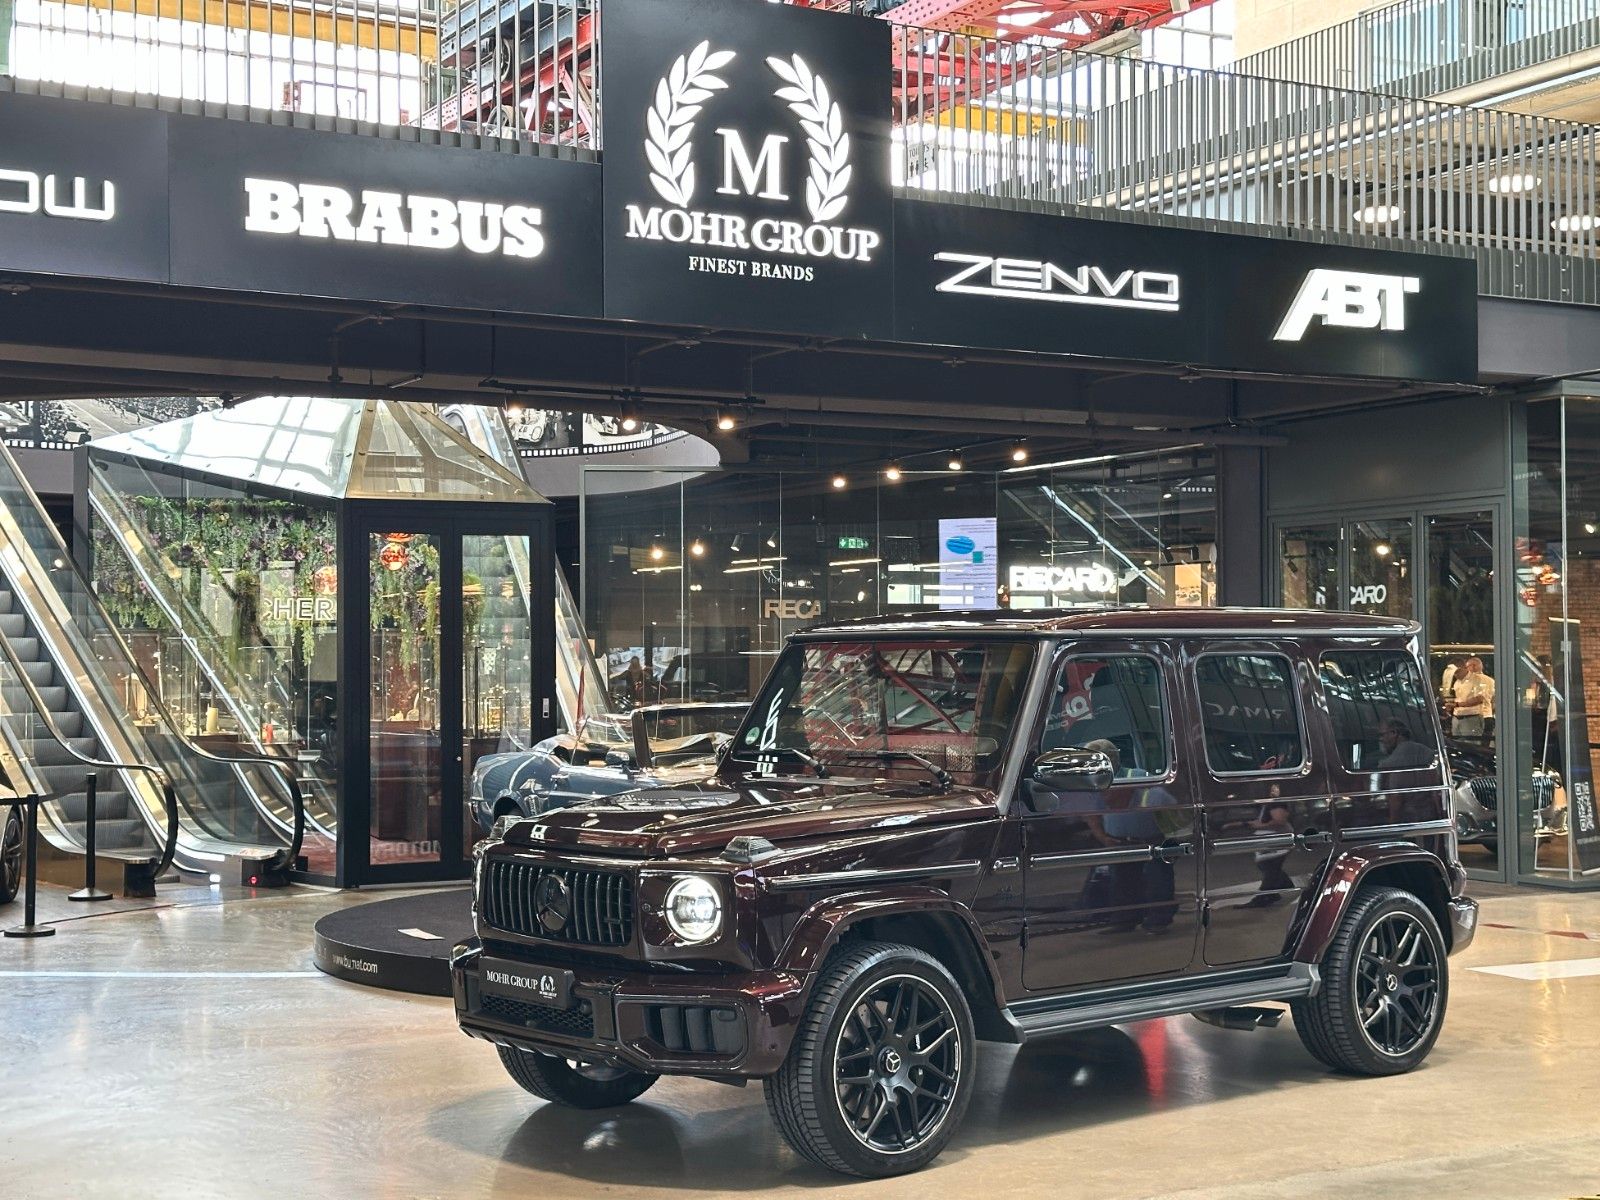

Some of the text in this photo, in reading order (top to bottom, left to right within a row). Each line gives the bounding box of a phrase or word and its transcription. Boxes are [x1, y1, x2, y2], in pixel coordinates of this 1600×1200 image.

[715, 128, 790, 201] M
[244, 177, 545, 259] BRABUS
[624, 204, 881, 262] MOHR GROUP
[688, 255, 815, 282] FINEST BRANDS
[933, 251, 1180, 312] ZENVO
[1272, 268, 1420, 342] ABT
[1009, 563, 1116, 593] RECARO
[486, 970, 539, 990] MOHR GROUP
